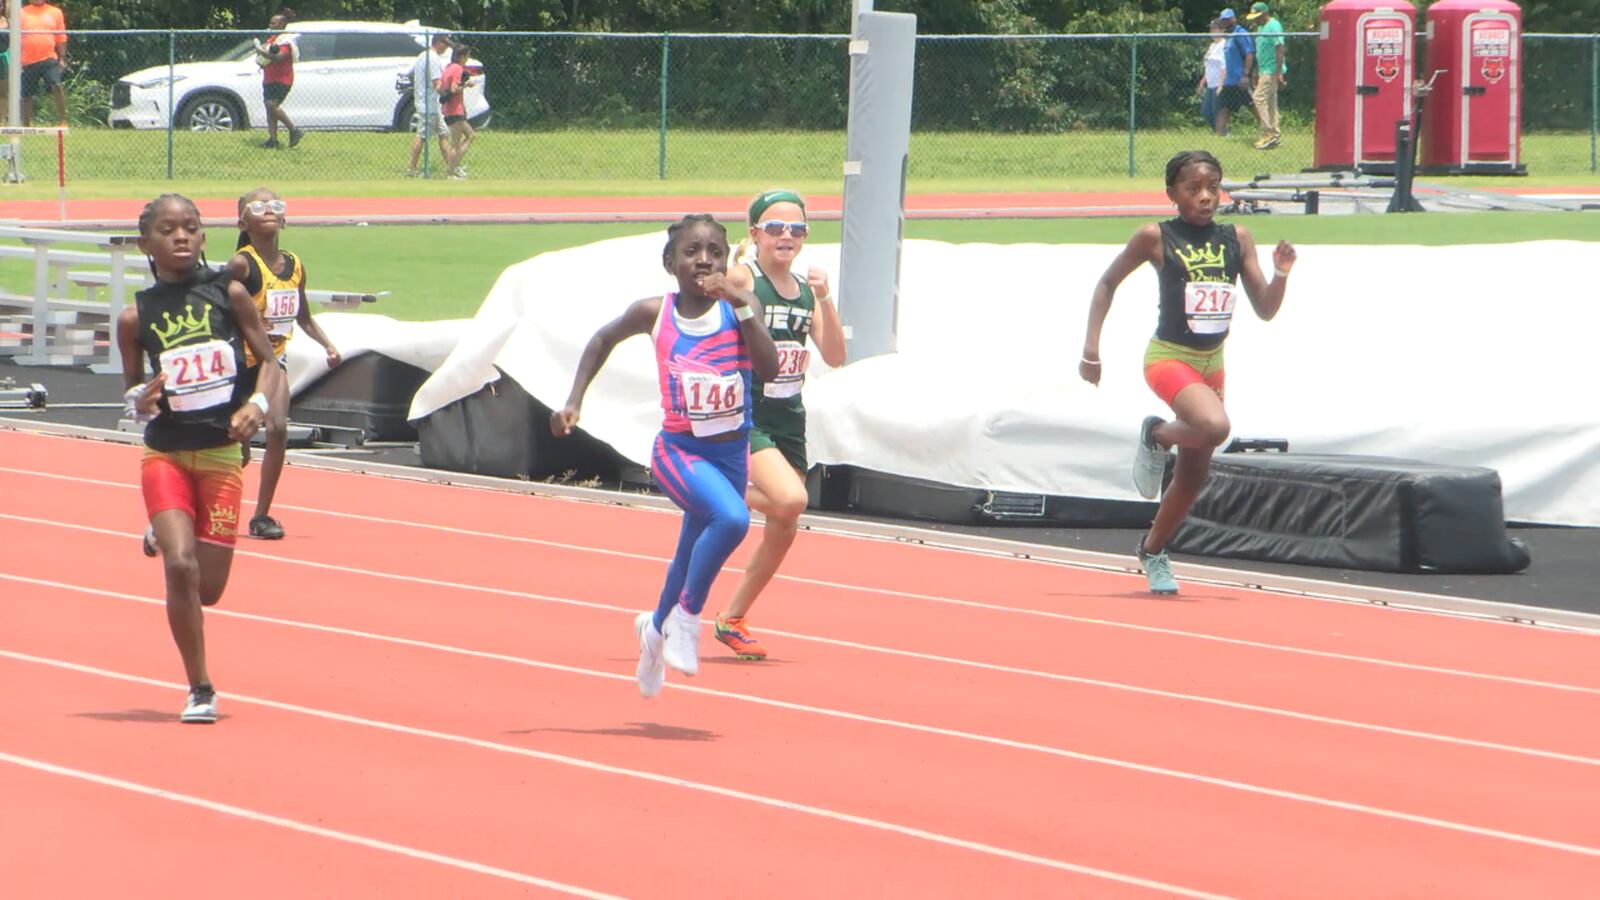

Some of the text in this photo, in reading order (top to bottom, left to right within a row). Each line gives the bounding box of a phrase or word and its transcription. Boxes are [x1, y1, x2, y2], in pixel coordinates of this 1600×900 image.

[272, 295, 295, 316] 156
[1194, 289, 1231, 312] 217
[172, 350, 225, 386] 214
[690, 382, 736, 410] 146
